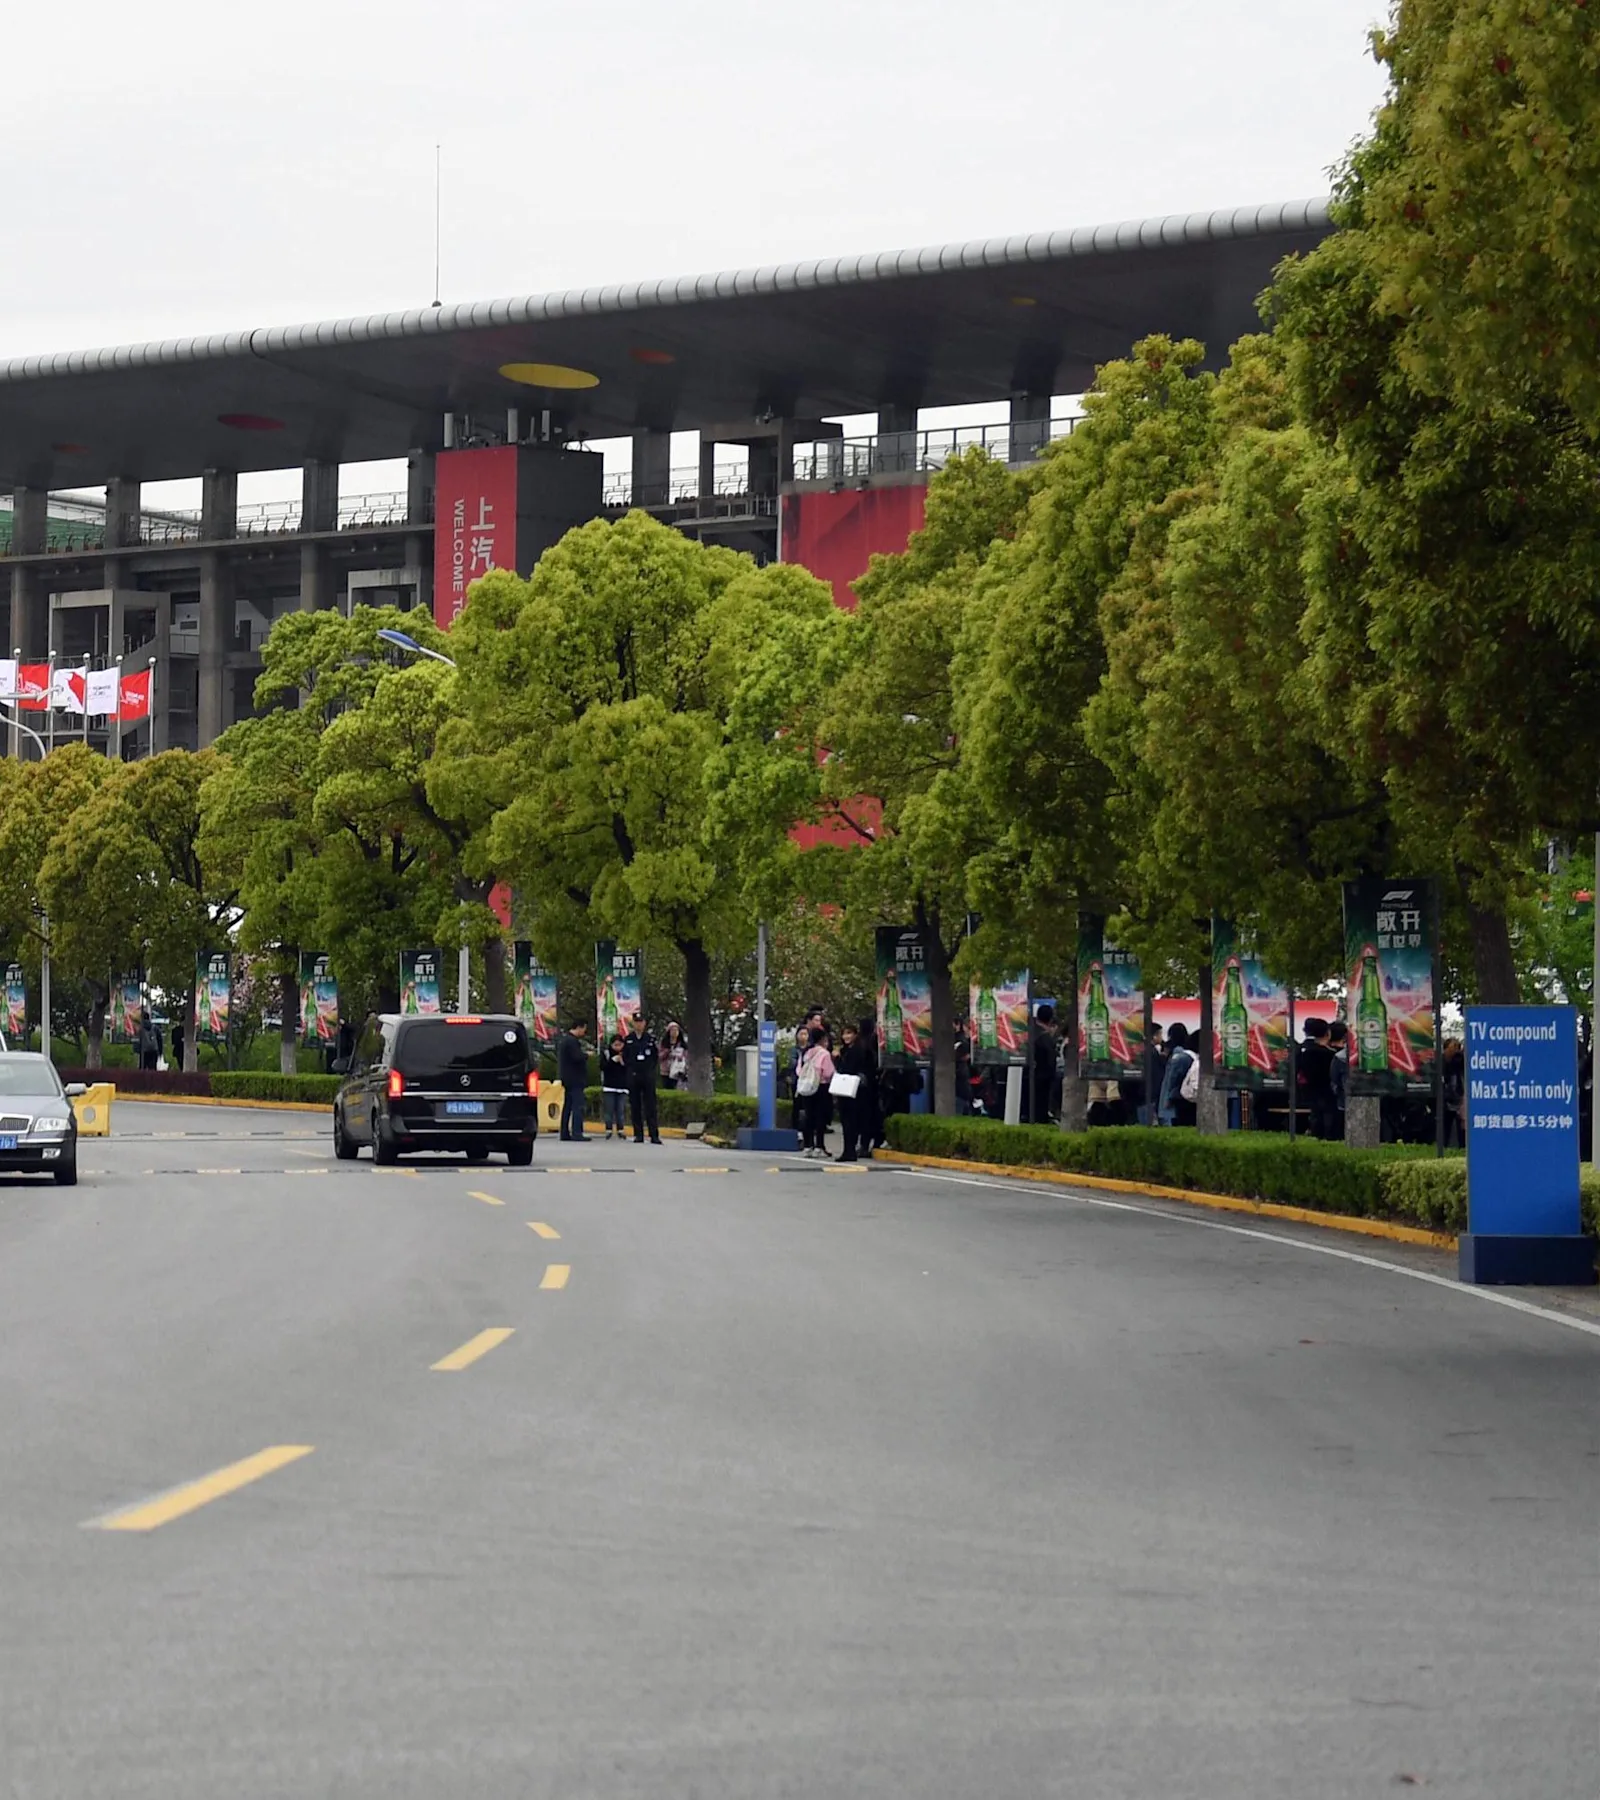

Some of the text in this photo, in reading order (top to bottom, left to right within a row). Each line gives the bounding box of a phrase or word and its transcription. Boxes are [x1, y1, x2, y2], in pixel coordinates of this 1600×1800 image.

[453, 499, 465, 592] WELCOME
[469, 496, 496, 582] 上汽
[1376, 910, 1420, 932] 敞开
[1470, 1021, 1556, 1045] TV compound
[1470, 1051, 1522, 1075] delivery
[1471, 1080, 1572, 1104] Max 15 min only
[1473, 1114, 1573, 1129] 卸货最多15分钟
